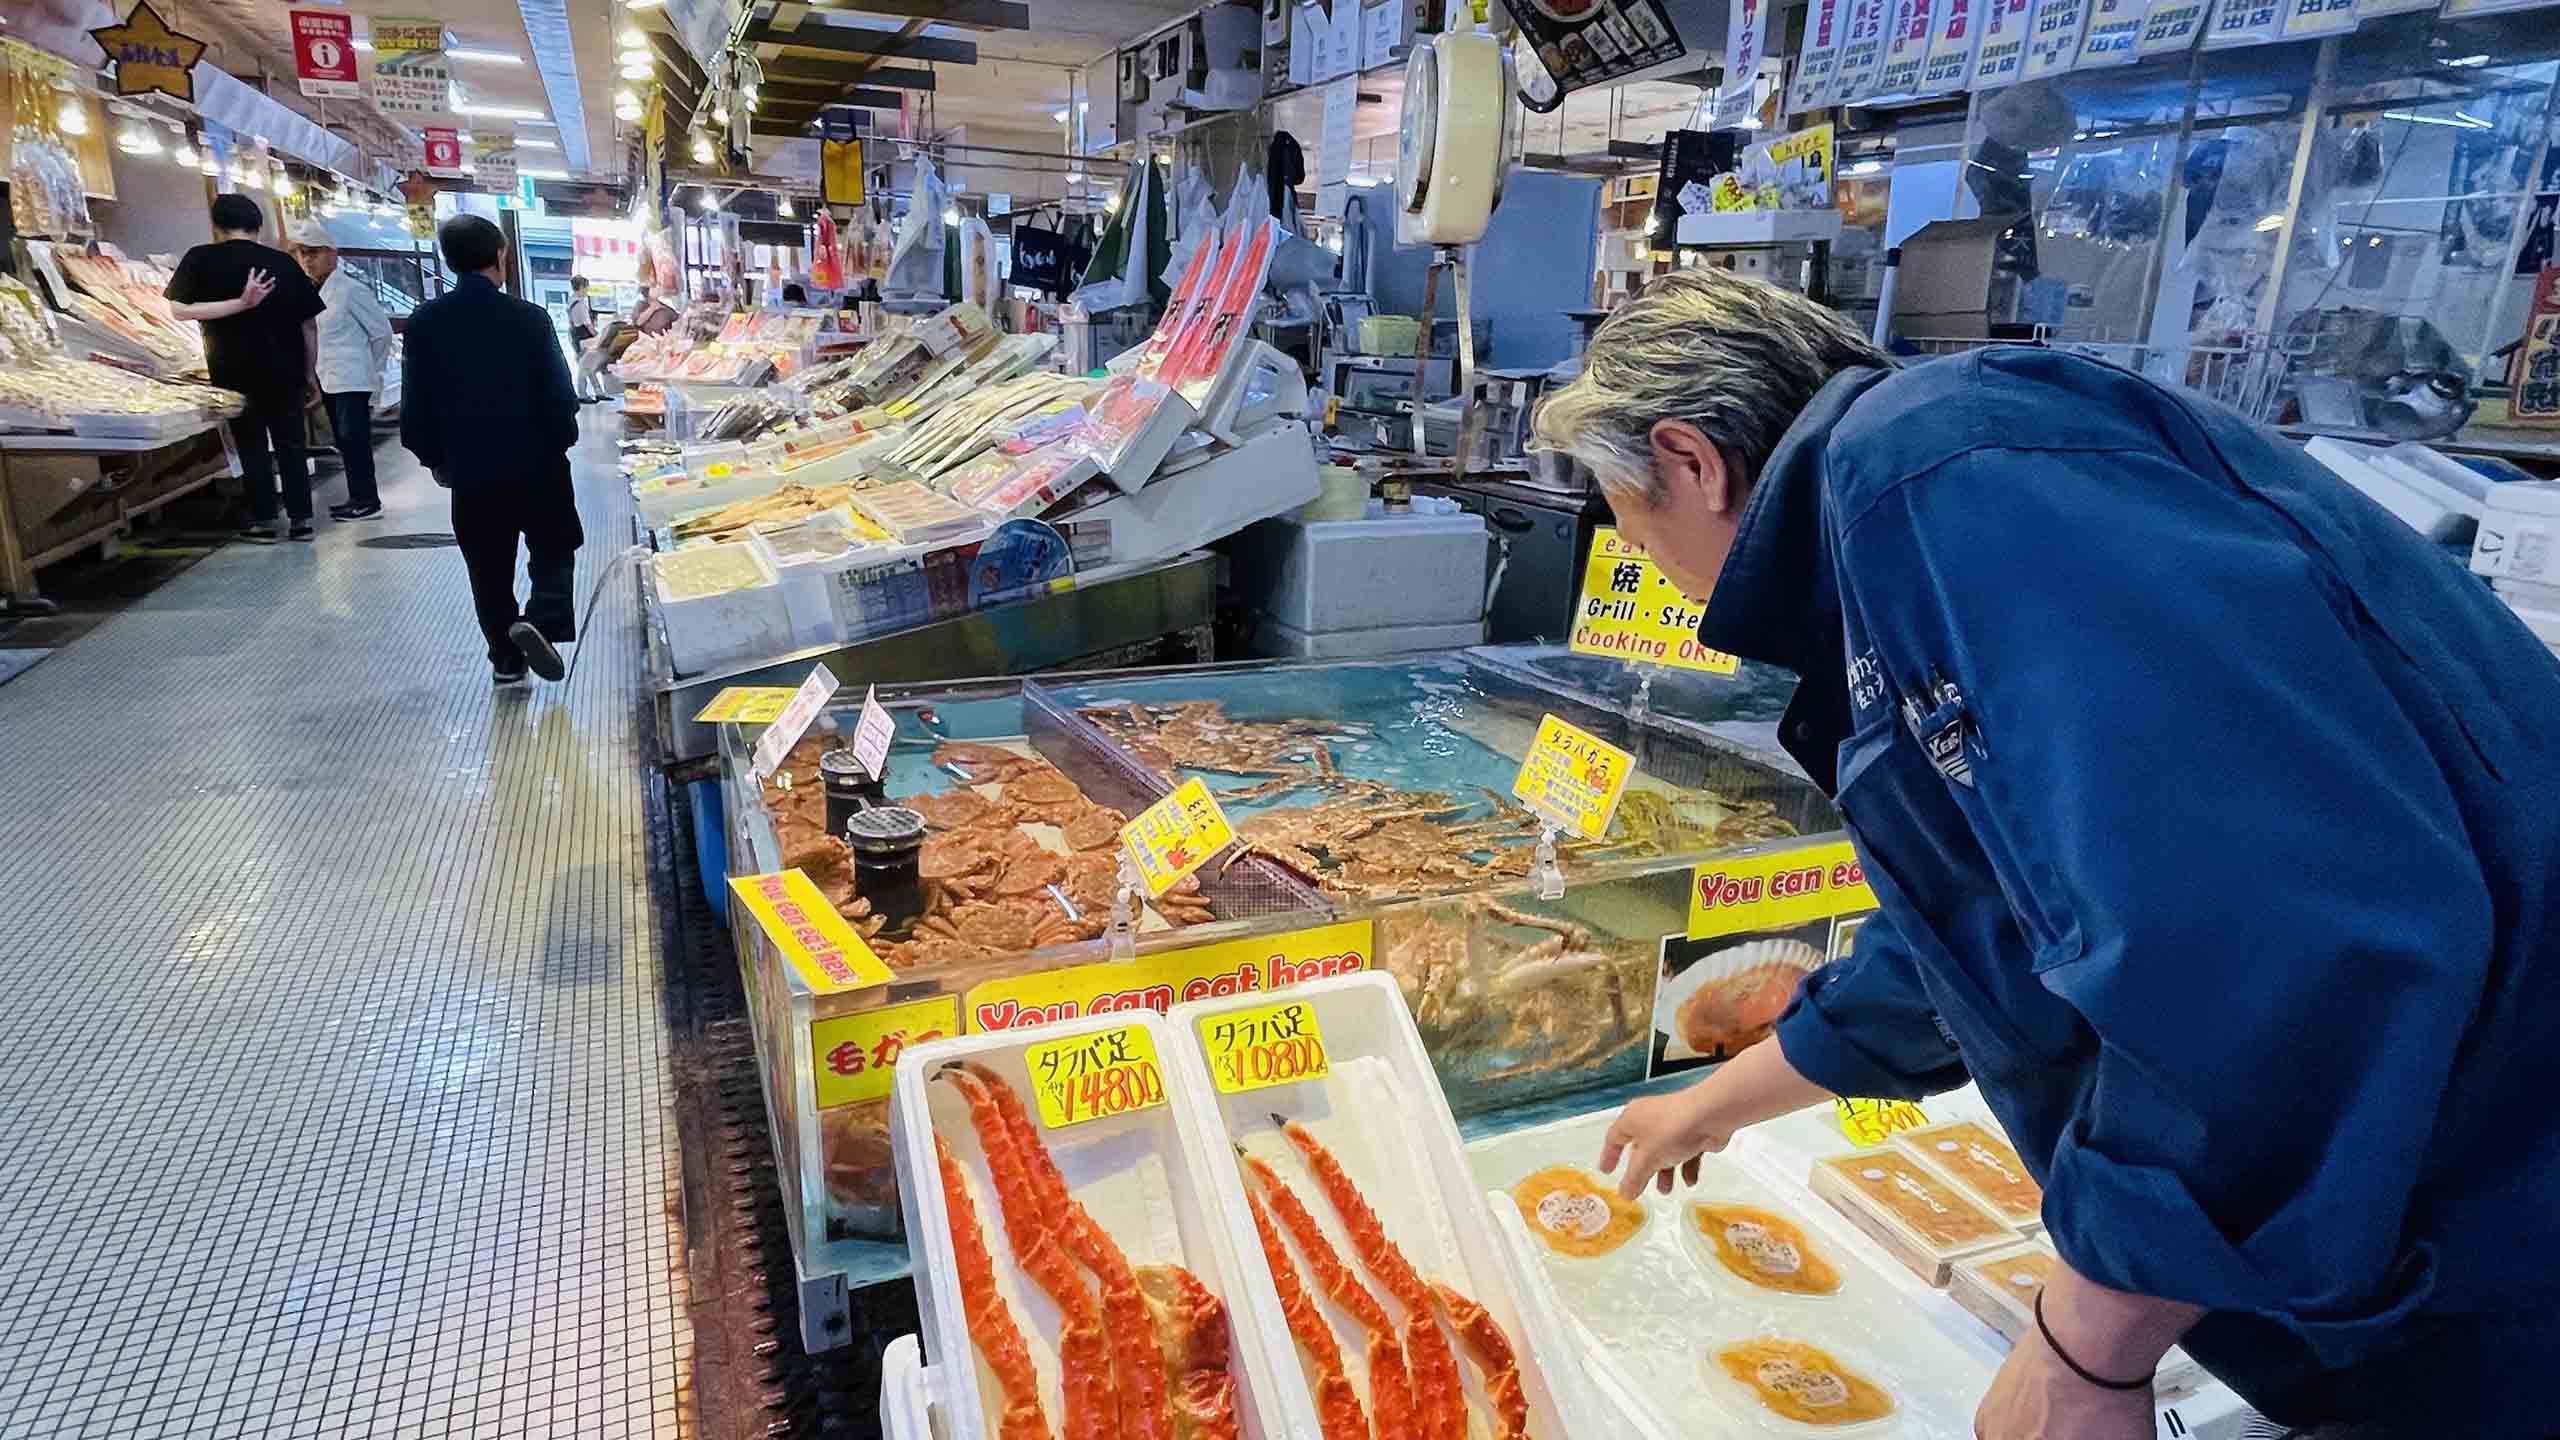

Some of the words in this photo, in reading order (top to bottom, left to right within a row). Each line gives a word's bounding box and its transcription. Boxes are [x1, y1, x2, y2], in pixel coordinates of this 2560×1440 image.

[1605, 537, 1646, 554] ea
[1587, 597, 1636, 621] Grill
[1659, 606, 1700, 629] Ste
[1576, 626, 1667, 658] Cooking
[1699, 872, 1764, 911] You
[1769, 864, 1826, 899] can
[1830, 860, 1867, 889] ea
[975, 998, 1079, 1032] You
[1087, 984, 1174, 1018] can
[1181, 963, 1260, 1003] eat
[1267, 951, 1364, 988] here
[1214, 1005, 1313, 1053] タラバ足
[1039, 1030, 1143, 1082] タラバ足
